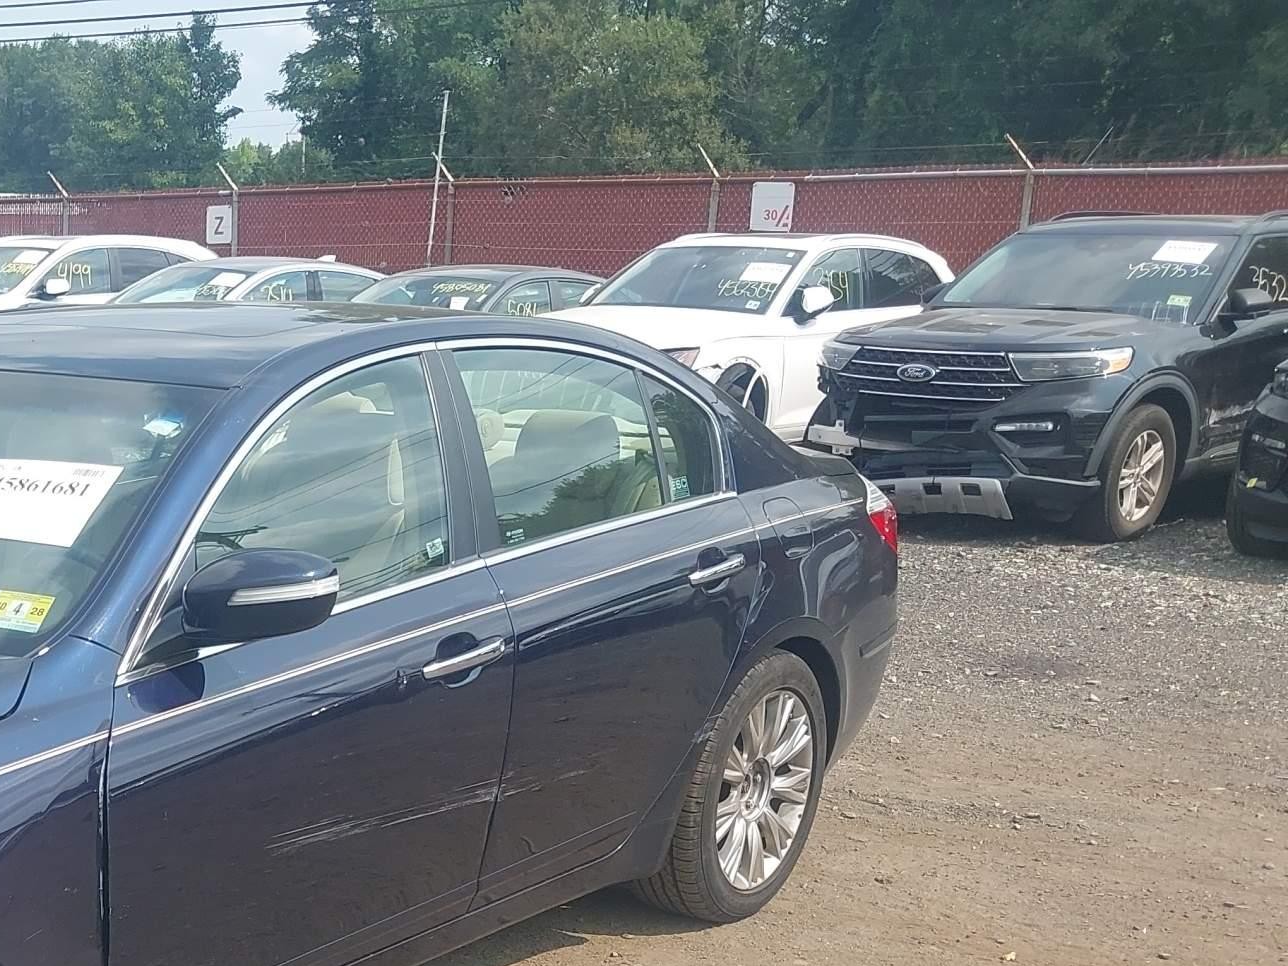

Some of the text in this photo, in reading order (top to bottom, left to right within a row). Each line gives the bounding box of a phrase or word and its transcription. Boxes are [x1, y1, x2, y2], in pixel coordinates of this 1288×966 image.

[214, 216, 224, 235] Z
[57, 262, 91, 288] 4199
[13, 602, 24, 616] 4
